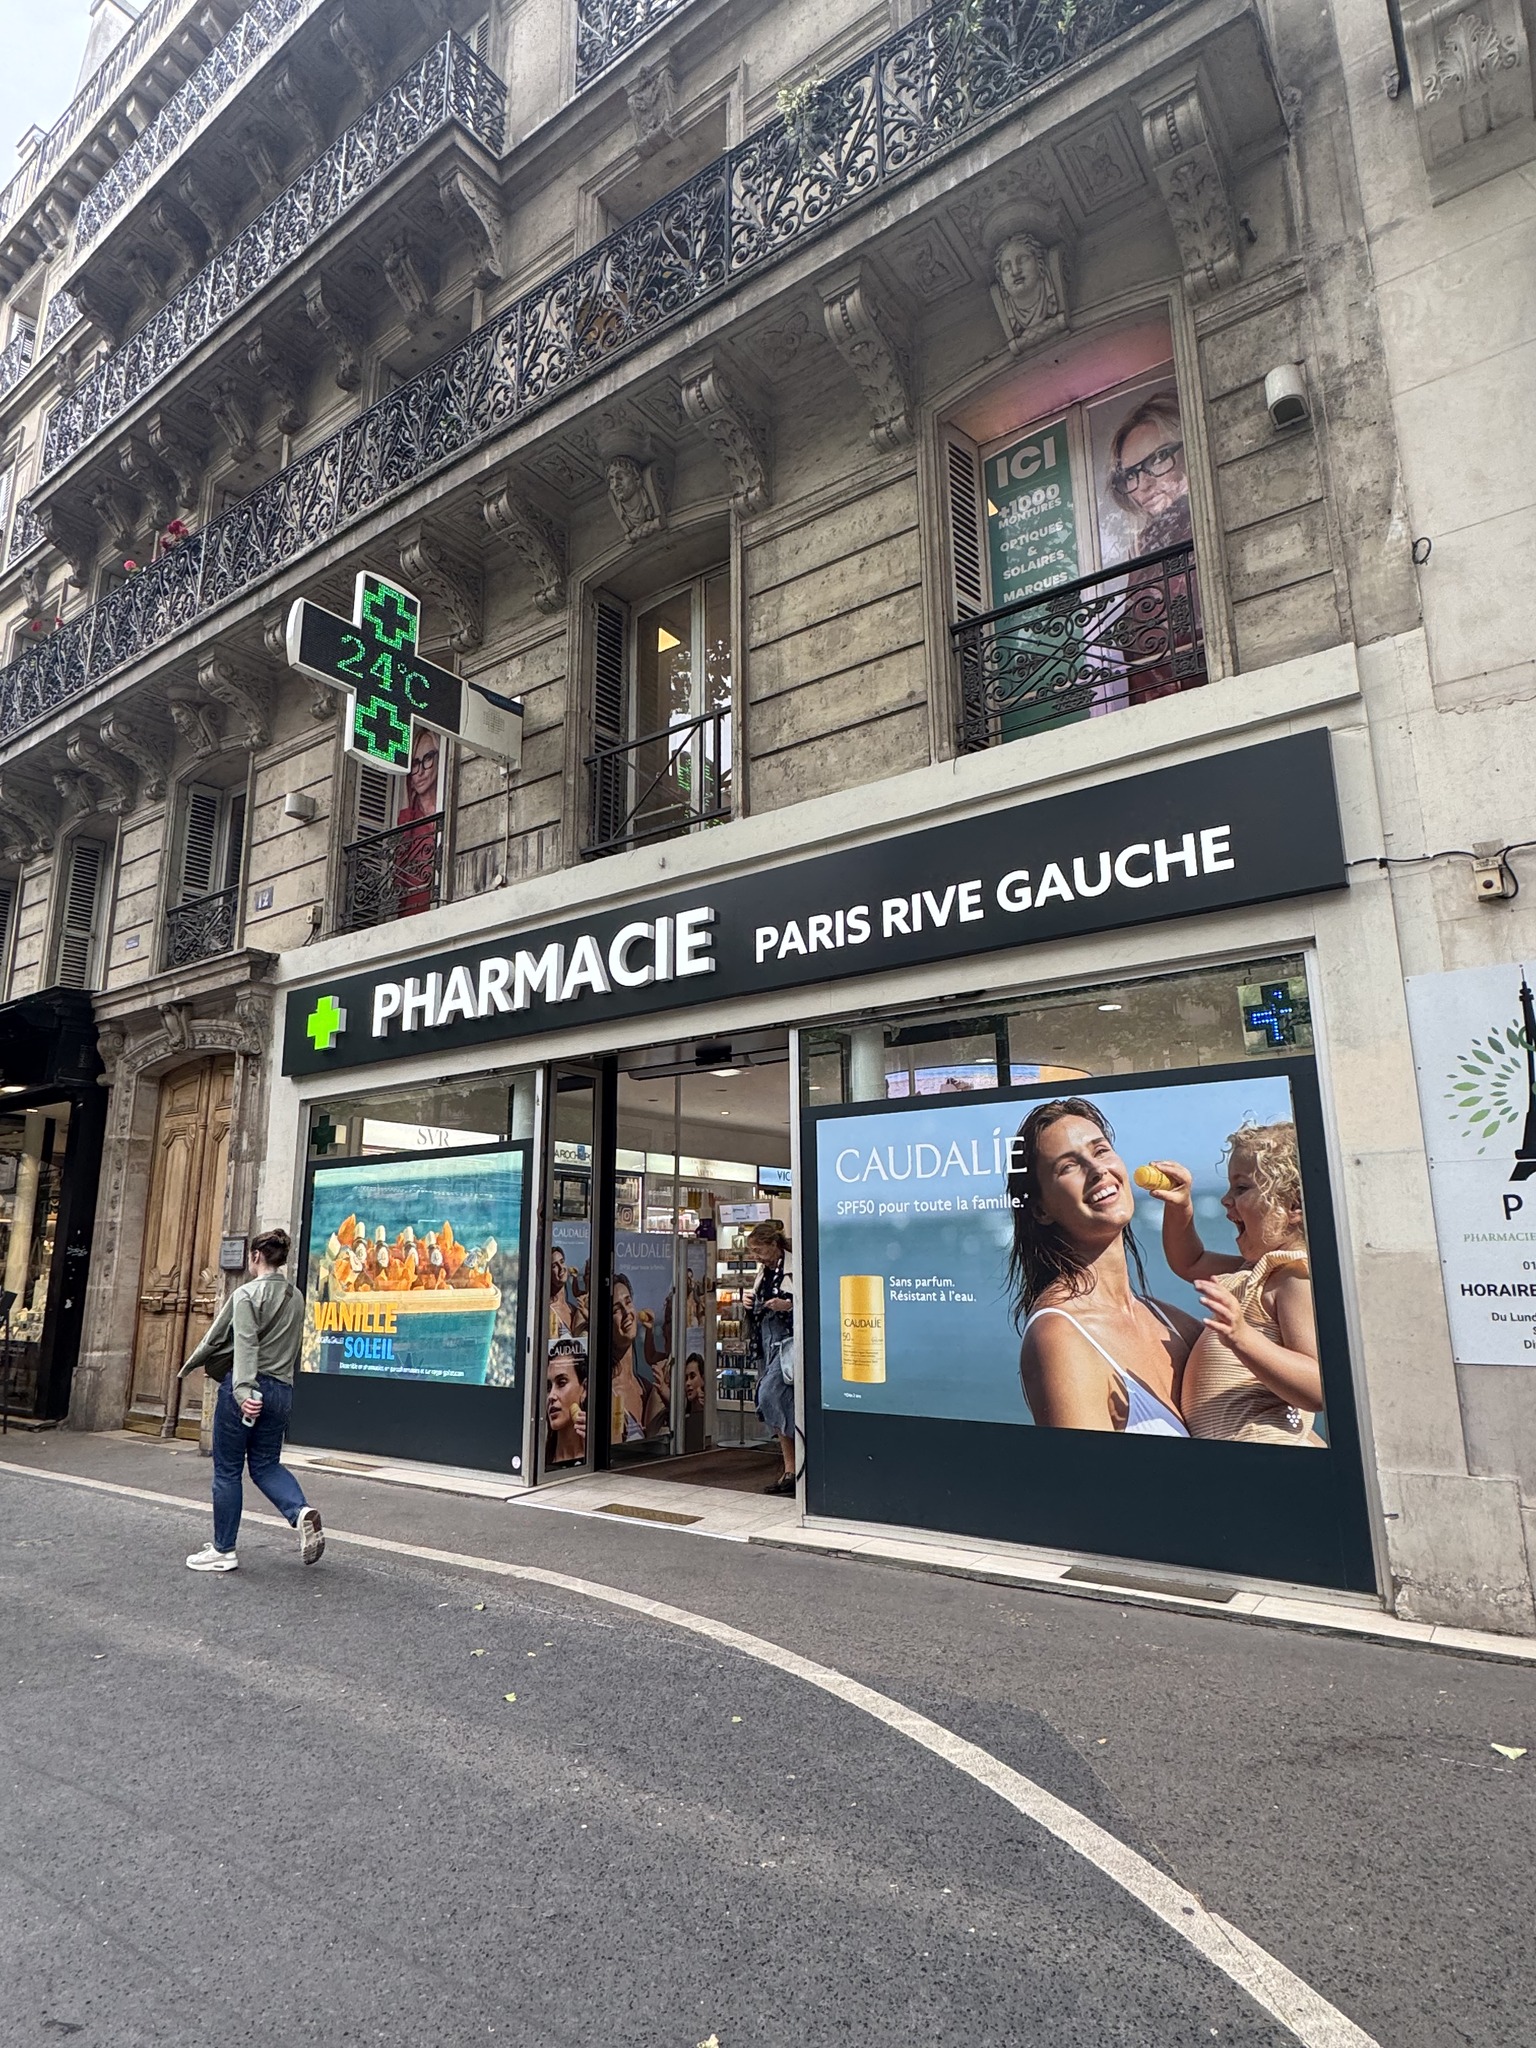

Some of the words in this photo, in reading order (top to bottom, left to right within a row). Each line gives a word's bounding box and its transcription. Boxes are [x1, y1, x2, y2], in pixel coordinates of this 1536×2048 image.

[996, 436, 1057, 488] ICI
[998, 483, 1060, 518] +1000
[998, 498, 1062, 529] MONTURES
[1000, 520, 1064, 552] OPTIQUES
[1003, 550, 1065, 580] SOLAIRES
[1027, 546, 1038, 557] &
[1003, 571, 1068, 603] MARQUES
[337, 633, 430, 710] 24°C
[371, 905, 716, 1039] PHARMACIE
[754, 904, 872, 964] PARIS
[882, 879, 984, 939] RIVE
[996, 824, 1236, 913] GAUCHE
[416, 1127, 450, 1147] SVR
[835, 1126, 1028, 1183] CAUDALÍE
[837, 1200, 875, 1215] SPF50
[878, 1201, 910, 1217] pour
[913, 1199, 951, 1212] toute
[956, 1196, 969, 1211] la
[1502, 1194, 1524, 1220] P
[1463, 1232, 1536, 1242] PHARMACIE
[889, 1275, 912, 1288] Sans
[915, 1276, 956, 1289] parfum.
[889, 1289, 938, 1302] Résistant
[939, 1290, 946, 1302] à
[1460, 1283, 1536, 1297] HORAIRE
[313, 1300, 399, 1334] VANILLE
[1491, 1312, 1507, 1322] Du
[343, 1336, 395, 1360] SOLEIL
